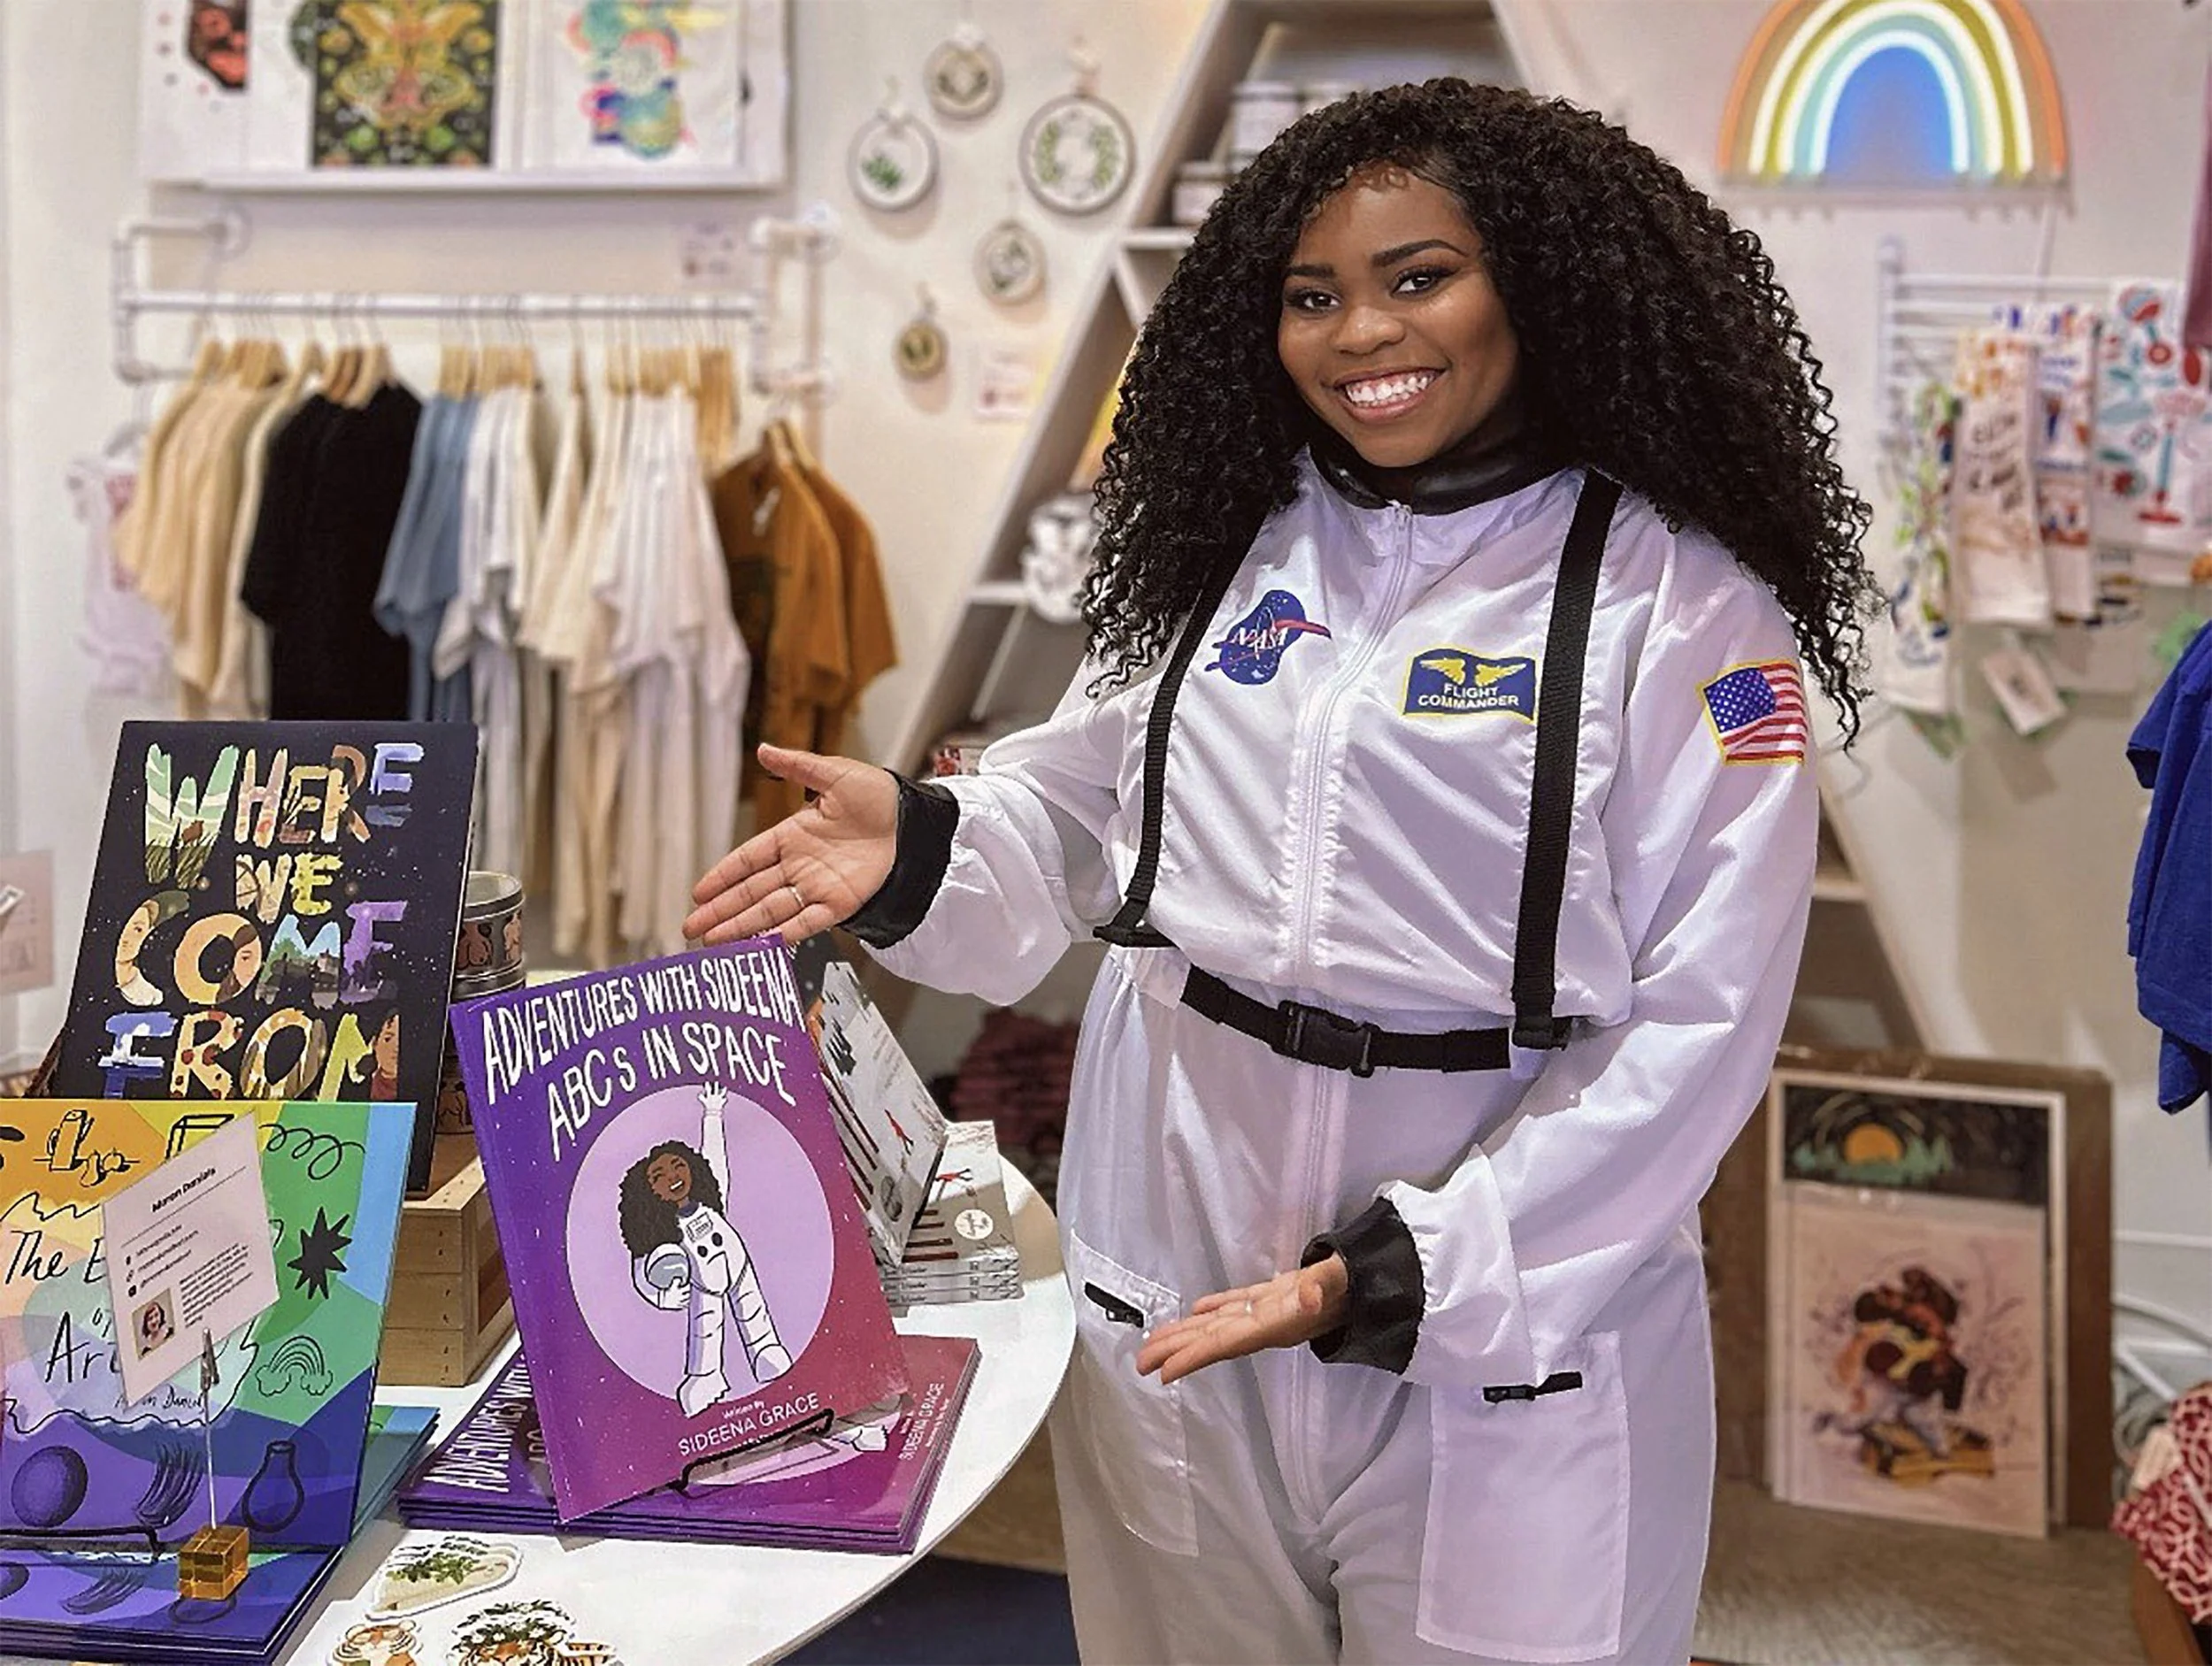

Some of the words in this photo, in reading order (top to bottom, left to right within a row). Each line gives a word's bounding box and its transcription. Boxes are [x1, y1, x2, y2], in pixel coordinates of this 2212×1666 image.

[1417, 695, 1519, 709] COMMANDER
[1444, 682, 1500, 698] FLIGHT
[144, 742, 426, 889] WHERE
[234, 851, 344, 925] WE
[115, 889, 409, 1010] COME
[97, 1007, 400, 1102] FROM
[481, 974, 638, 1105] ADVENTURES
[637, 963, 702, 1016] WITH
[701, 947, 808, 1033] SIDEENA
[641, 1025, 683, 1080] IN
[681, 1020, 796, 1107] SPACE
[4, 1230, 69, 1285] The
[678, 1417, 757, 1456] SIDEENA
[759, 1392, 820, 1427] GRACE
